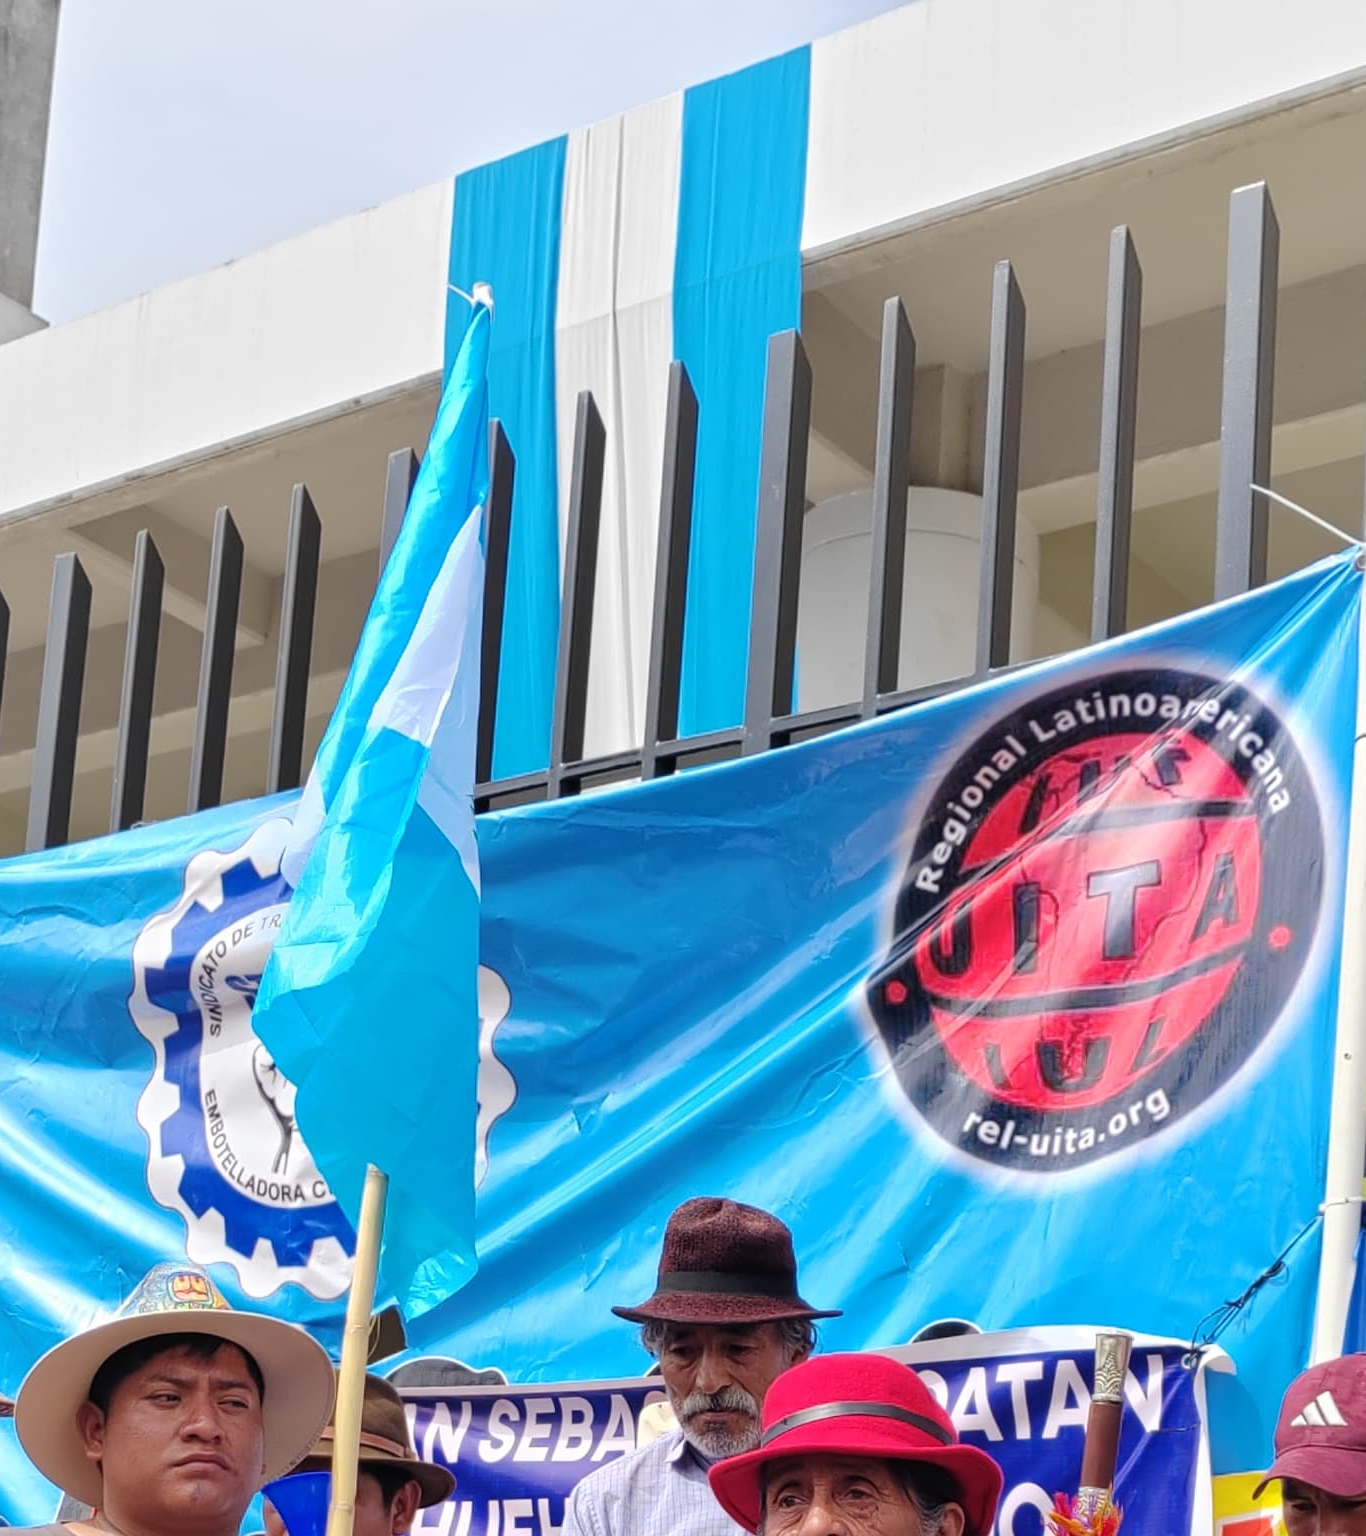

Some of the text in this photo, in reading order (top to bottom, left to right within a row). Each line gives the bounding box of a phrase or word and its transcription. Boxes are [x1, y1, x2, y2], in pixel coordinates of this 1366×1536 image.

[916, 732, 1027, 894] Regional
[929, 852, 1239, 979] UITA
[198, 940, 228, 1038] SINDICATO
[232, 922, 254, 947] DE
[204, 1088, 339, 1201] EMBOTELLADORA C
[963, 1087, 1171, 1157] rel-uita.org
